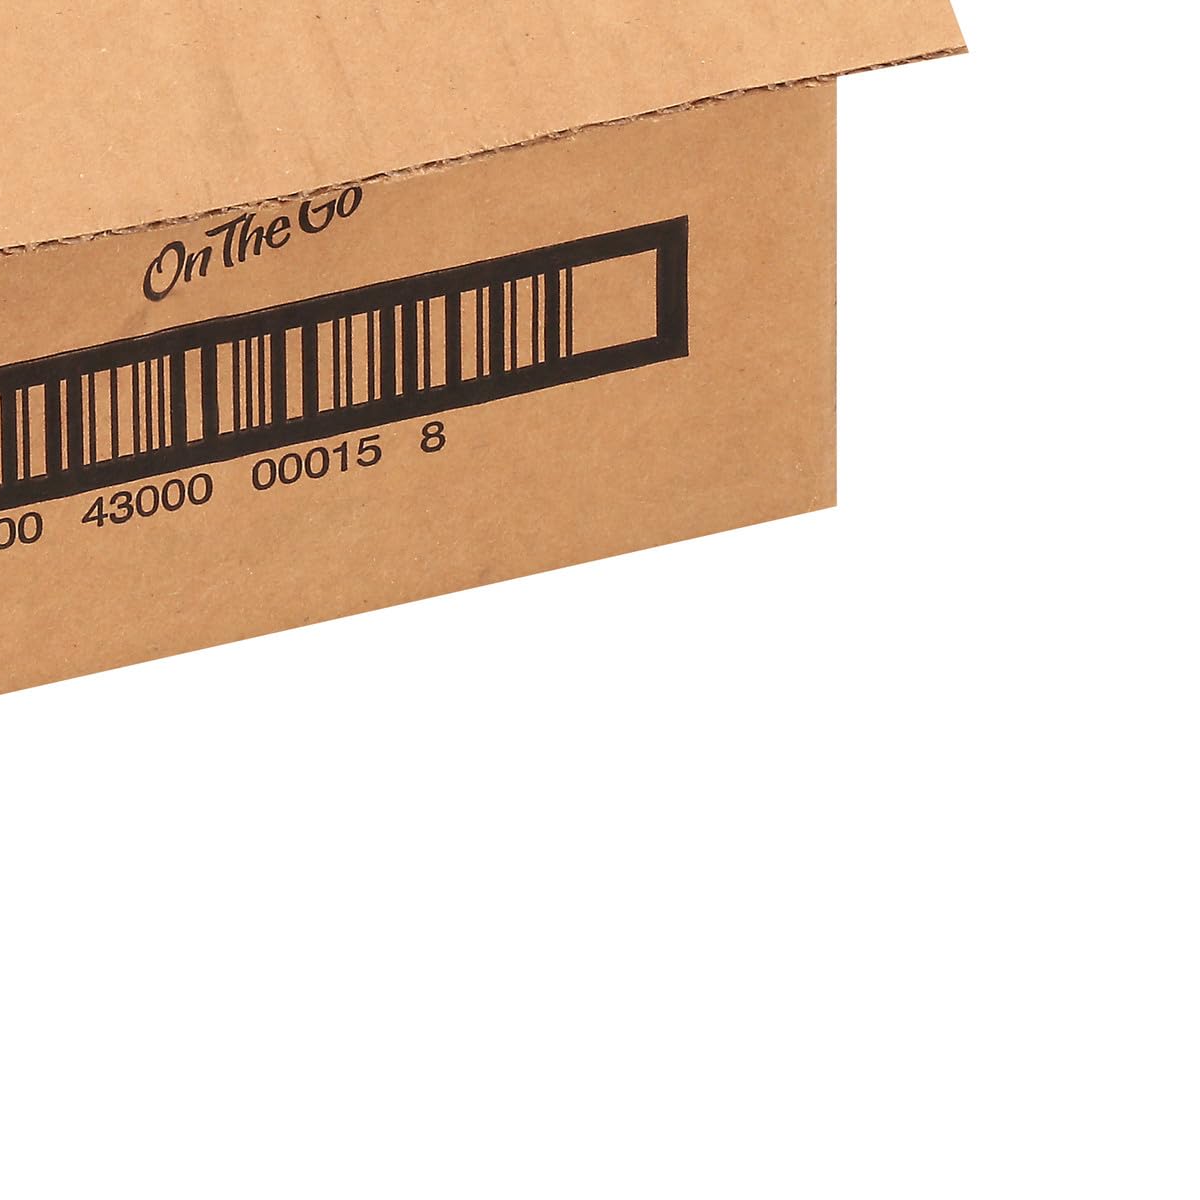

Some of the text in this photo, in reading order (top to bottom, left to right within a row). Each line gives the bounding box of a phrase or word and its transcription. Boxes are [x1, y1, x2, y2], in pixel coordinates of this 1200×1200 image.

[142, 240, 212, 301] On
[205, 212, 291, 268] The
[81, 473, 213, 528] 43000
[252, 434, 382, 491] 00015
[420, 421, 446, 453] 8
